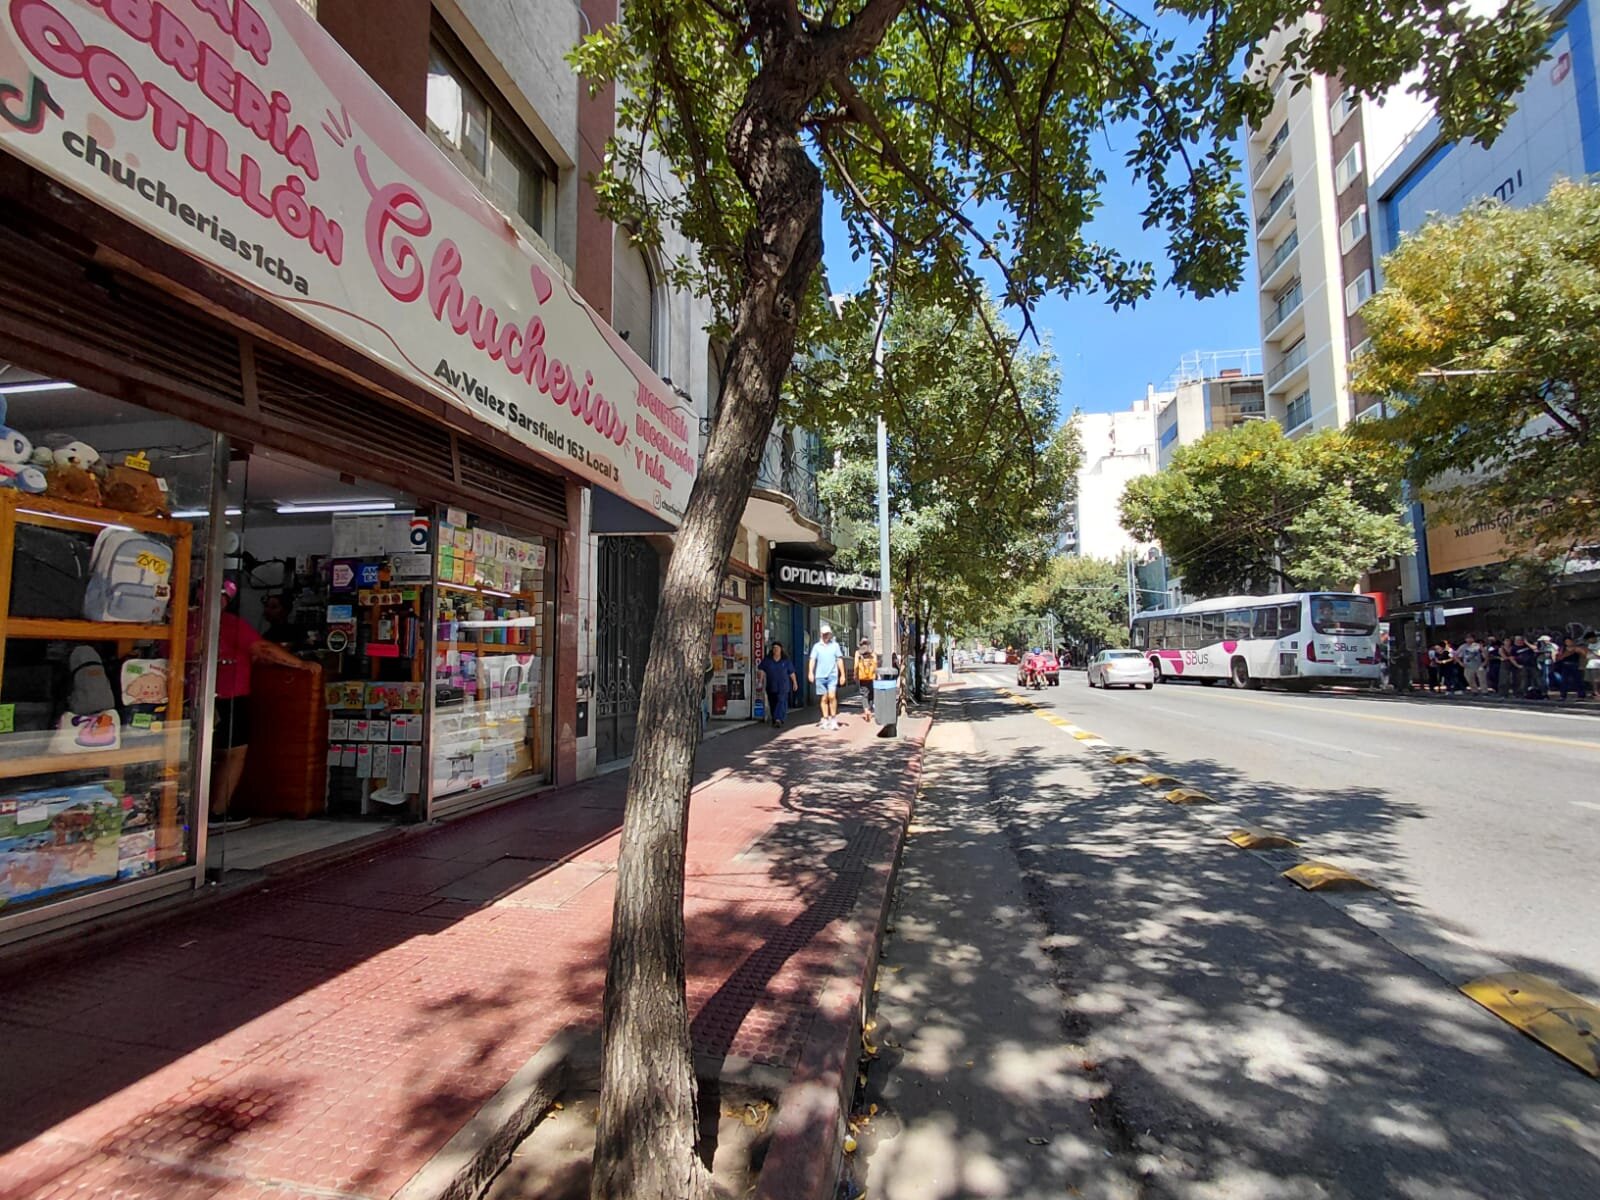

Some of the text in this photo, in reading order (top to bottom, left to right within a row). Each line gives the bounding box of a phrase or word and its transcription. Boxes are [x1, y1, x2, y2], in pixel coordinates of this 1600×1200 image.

[9, 0, 343, 266] COTILLÓN
[62, 131, 309, 296] chucherias1cba
[354, 146, 628, 446] Chucherias
[508, 402, 564, 451] Sarsfield
[566, 438, 584, 462] 163
[586, 451, 612, 480] Local
[613, 467, 619, 482] 3
[634, 446, 644, 470] Y
[635, 413, 694, 478] DECORACIÓN
[780, 565, 826, 586] OPTICA
[1185, 650, 1208, 665] SBus
[1334, 643, 1357, 652] SBus
